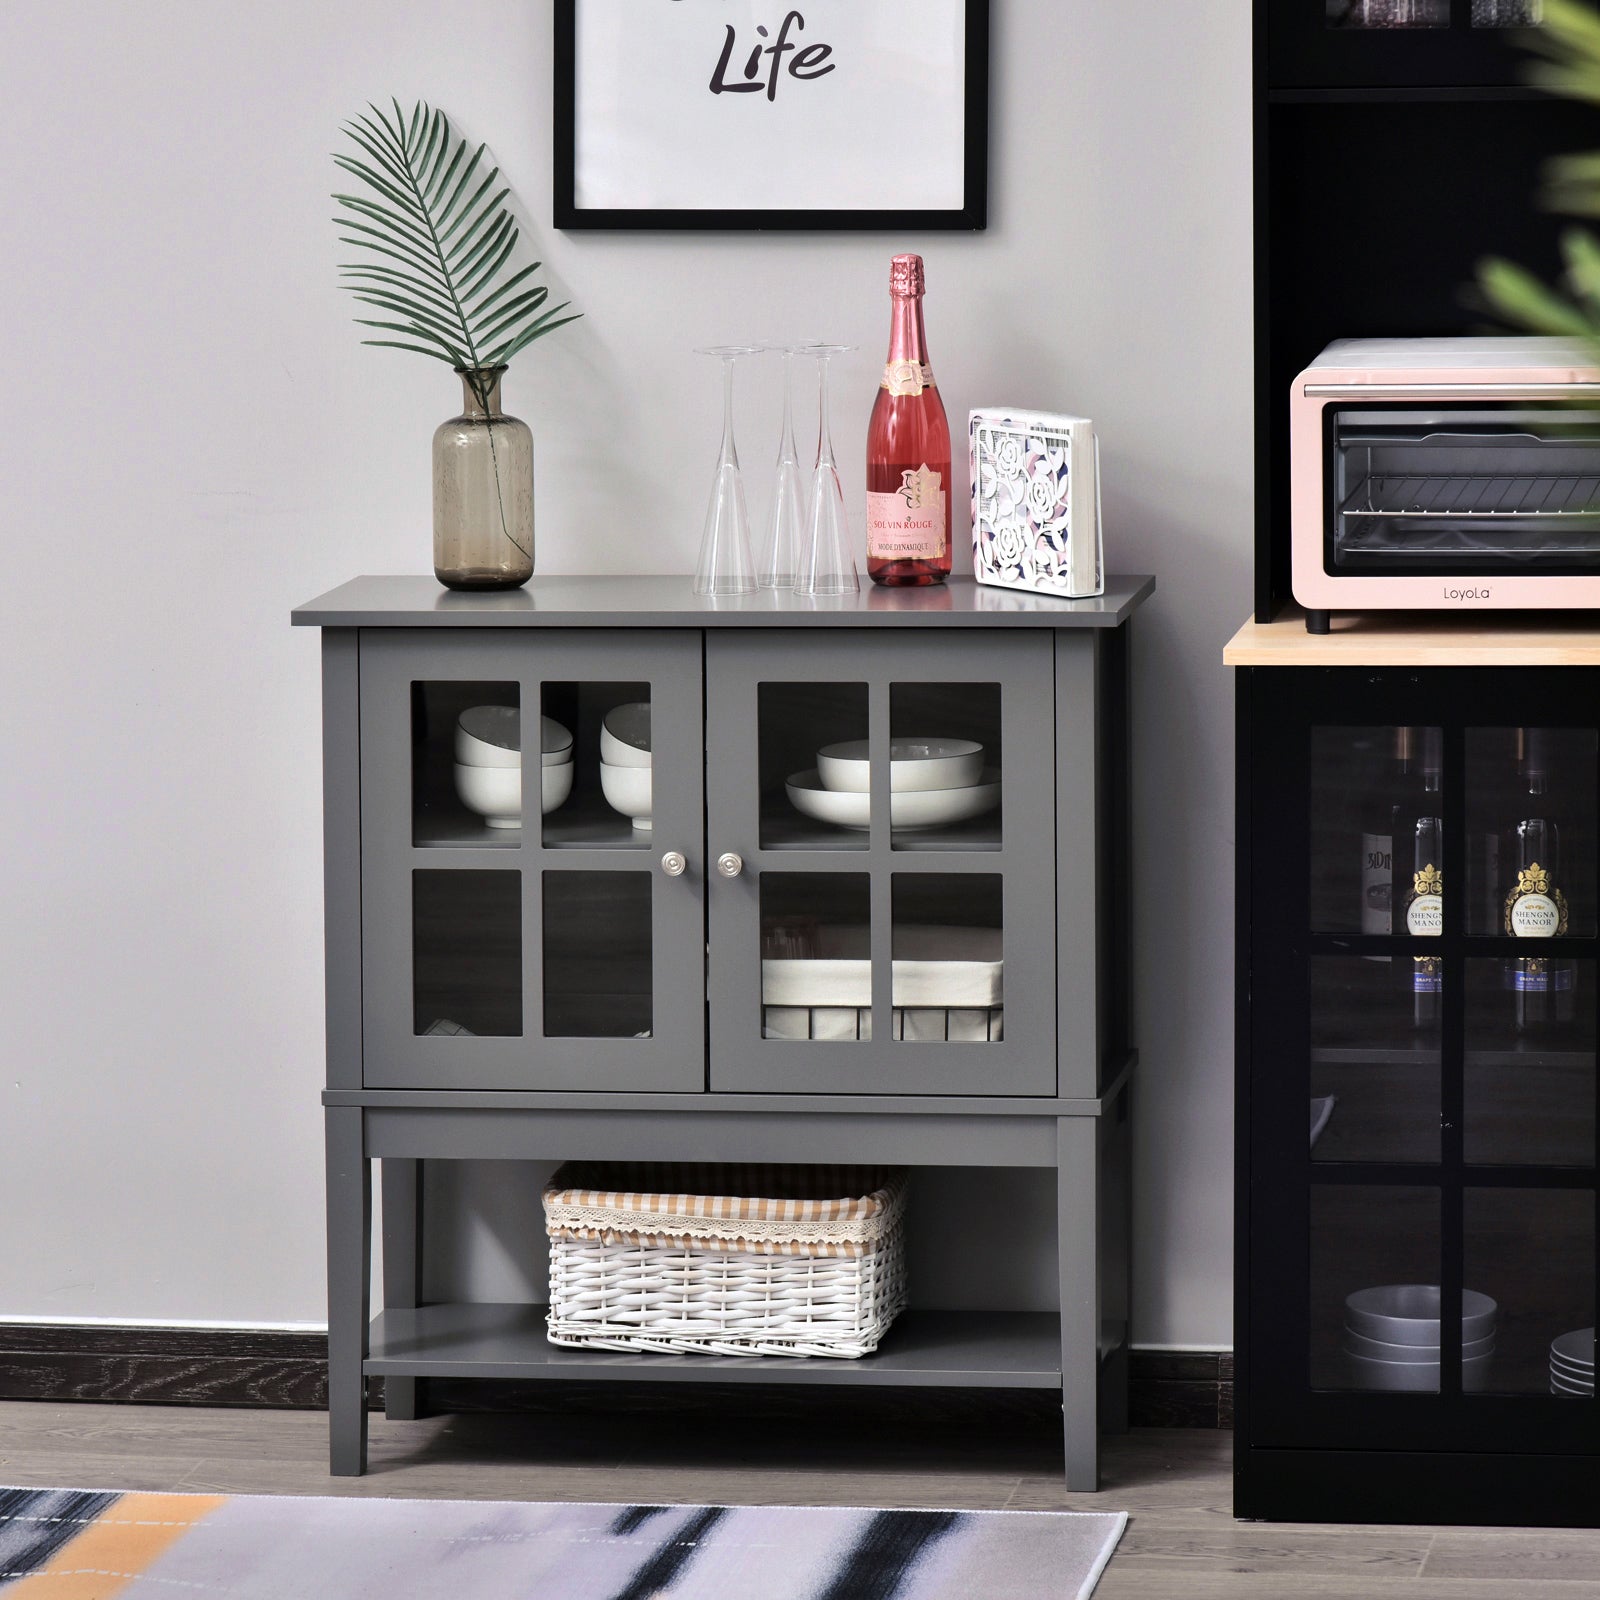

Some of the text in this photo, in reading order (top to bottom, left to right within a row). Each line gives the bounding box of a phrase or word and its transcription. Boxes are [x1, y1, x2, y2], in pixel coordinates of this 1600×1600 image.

[708, 10, 836, 102] Life
[873, 520, 933, 530] SOL VIN ROUGE
[1518, 918, 1552, 926] MANOR
